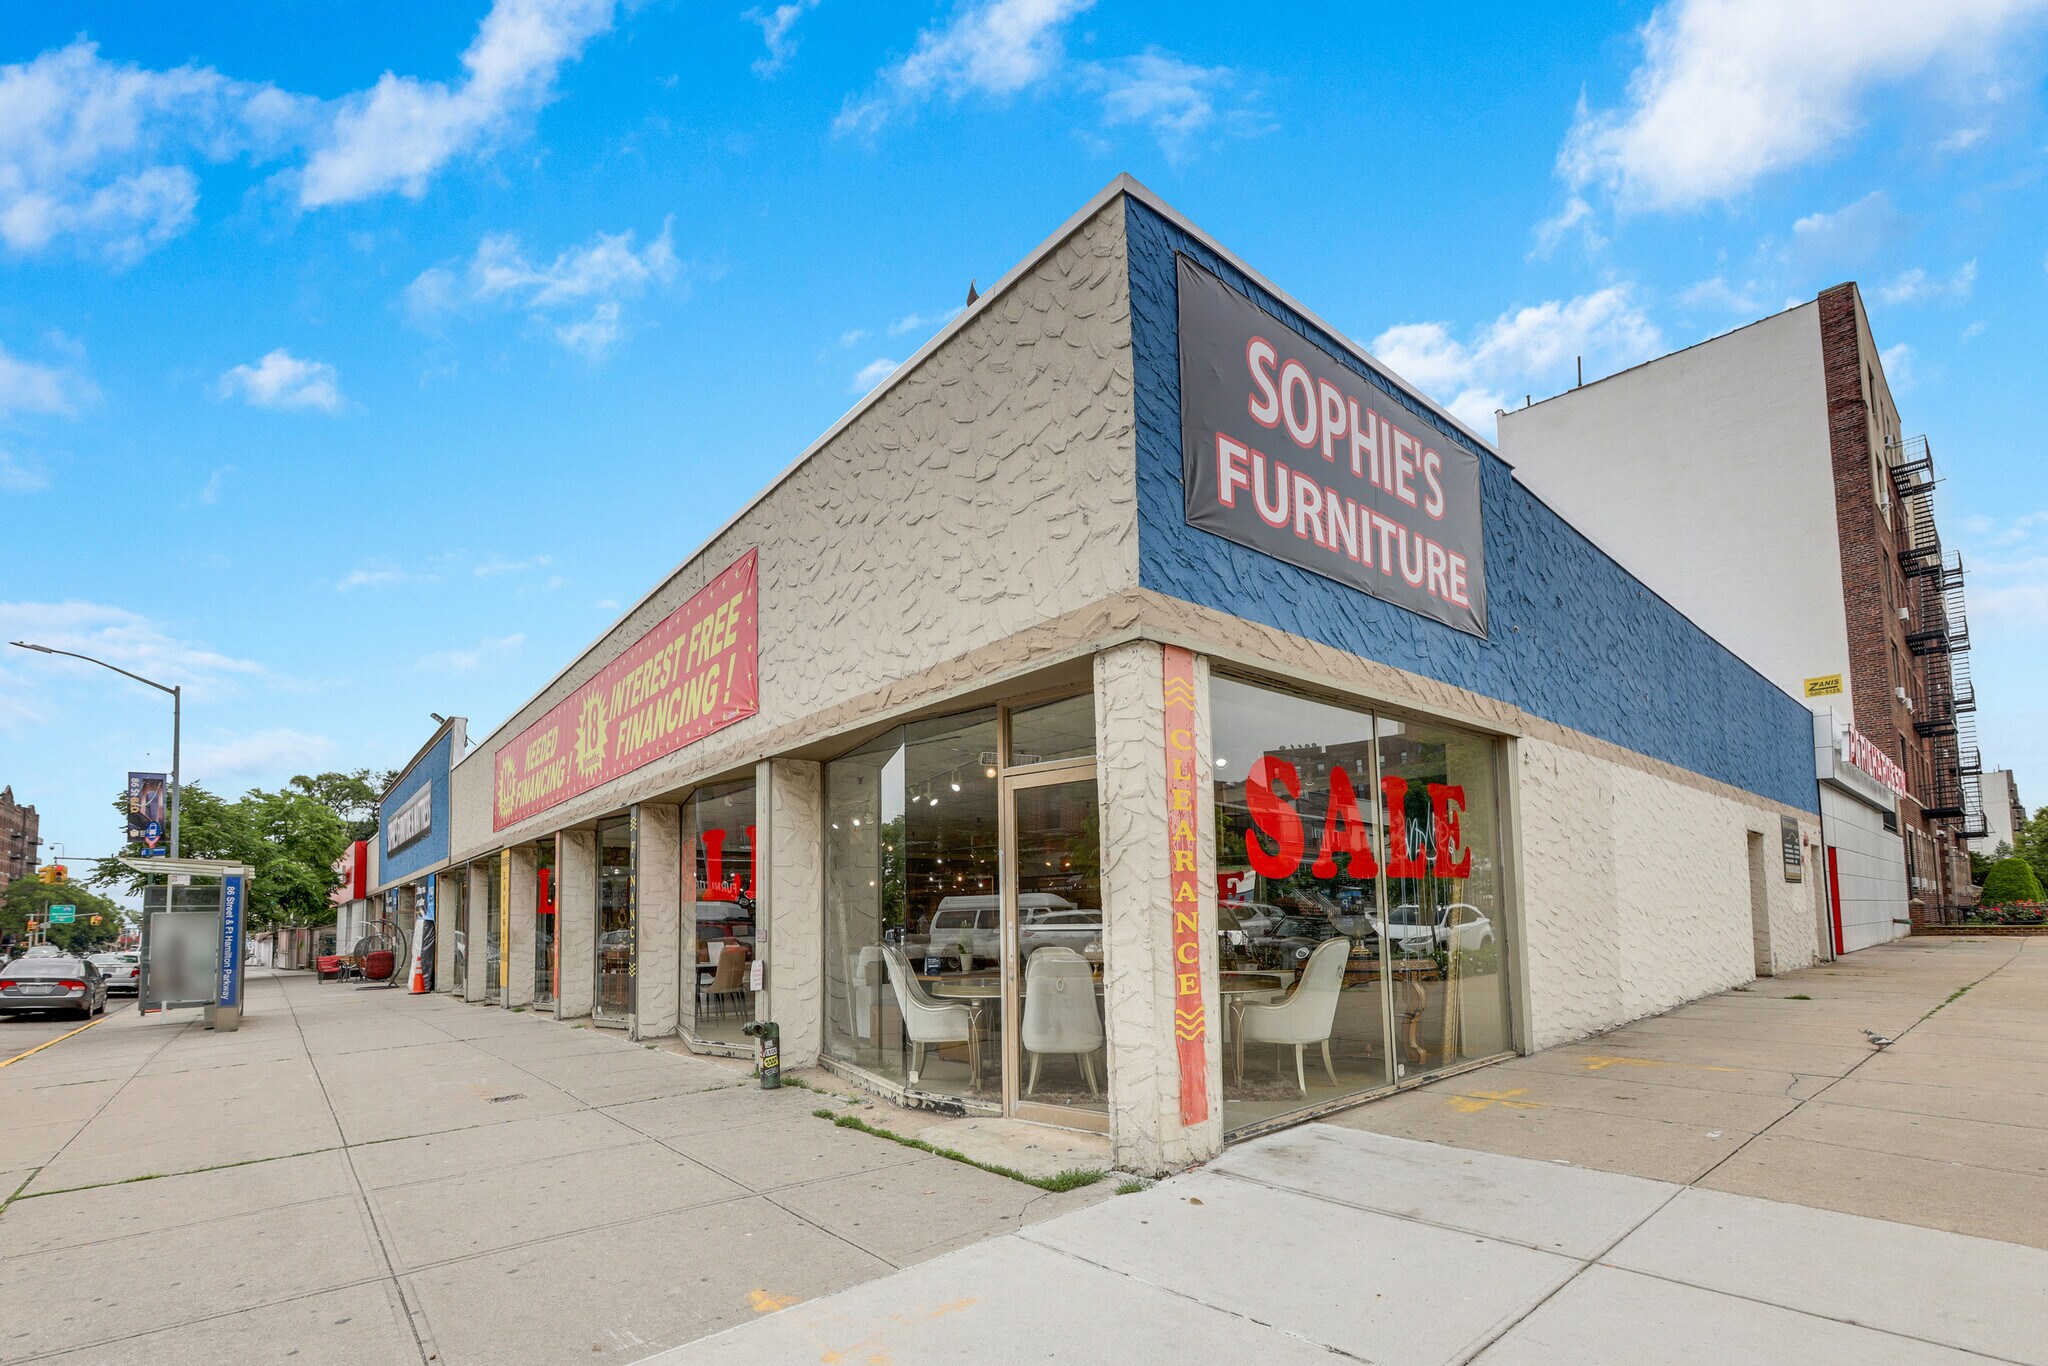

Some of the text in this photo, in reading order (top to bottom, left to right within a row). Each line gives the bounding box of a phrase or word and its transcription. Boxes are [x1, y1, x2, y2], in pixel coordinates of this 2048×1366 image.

[1246, 336, 1446, 520] SOPHIE'S
[1215, 431, 1471, 608] FURNITURE
[609, 591, 743, 722] INTEREST FREE
[524, 726, 559, 774] NEEDED
[583, 703, 599, 753] 18
[131, 777, 139, 788] 86
[1245, 756, 1472, 880] SALE
[1169, 728, 1200, 997] CLEARANCE
[225, 896, 235, 918] Street
[226, 886, 235, 896] 86
[223, 936, 233, 968] Hamilton
[225, 926, 234, 935] Ft
[220, 969, 232, 1000] Parkway
